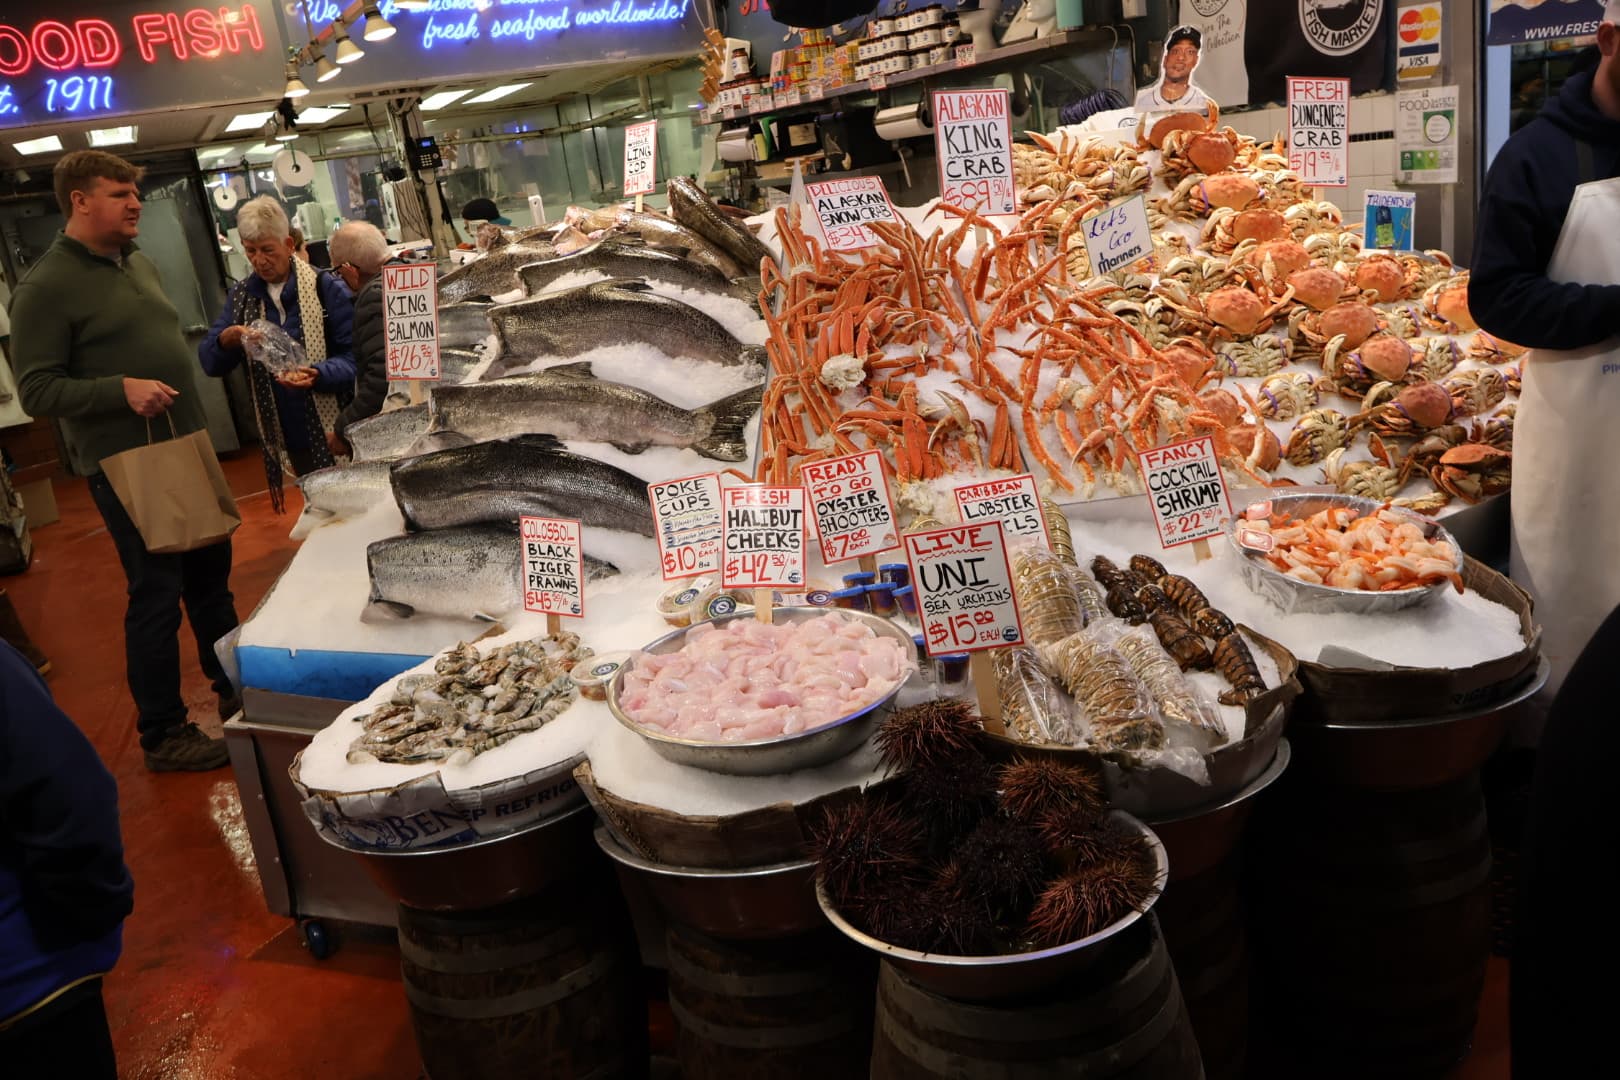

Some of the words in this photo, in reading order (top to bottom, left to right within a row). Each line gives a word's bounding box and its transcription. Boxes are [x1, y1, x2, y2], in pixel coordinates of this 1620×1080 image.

[133, 4, 263, 62] FISH
[423, 13, 480, 48] fresh
[491, 7, 570, 40] seafood
[575, 0, 689, 26] worldwide!
[1305, 8, 1330, 43] FISH
[1331, 0, 1378, 47] MARKET
[1409, 55, 1430, 67] VISA
[46, 75, 113, 112] 1911
[1292, 81, 1343, 100] FRESH
[939, 93, 1003, 121] ALASKAN
[1399, 99, 1431, 112] FOOD
[944, 121, 1003, 154] KING
[1293, 130, 1342, 147] CRAB
[627, 145, 652, 161] LING
[1290, 150, 1316, 177] $19
[628, 160, 647, 174] COD
[946, 156, 1006, 178] CRAB
[810, 178, 876, 197] DELICIOUS
[818, 191, 886, 212] ALASKAN
[820, 209, 860, 227] SNOW
[860, 205, 892, 220] CRAB
[1089, 207, 1127, 239] Let's
[827, 224, 867, 247] $34
[1109, 228, 1134, 250] Go
[386, 268, 429, 290] WILD
[386, 294, 428, 316] KING
[388, 320, 434, 341] SALMON
[389, 344, 421, 372] $26
[1145, 440, 1207, 468] FANCY
[809, 457, 866, 482] READY
[1148, 461, 1217, 491] COCKTAIL
[654, 478, 707, 501] POKE
[814, 484, 842, 497] TO
[849, 476, 872, 490] GO
[959, 481, 1023, 501] CARIBBEAN
[658, 492, 711, 516] CUPS
[731, 490, 790, 506] FRESH
[817, 490, 880, 516] OYSTER
[963, 494, 1035, 519] LOBSTER
[1156, 482, 1222, 516] SHRIMP
[727, 508, 802, 529] HALIBUT
[819, 505, 890, 534] SHOOTERS
[1163, 512, 1204, 535] $22
[523, 519, 575, 541] COLOSSOL
[726, 532, 800, 550] CHEEKS
[527, 542, 574, 558] BLACK
[698, 546, 719, 557] EACH
[824, 534, 849, 558] $7
[849, 540, 870, 551] EACH
[911, 528, 992, 555] LIVE
[528, 560, 574, 576] TIGER
[663, 546, 696, 573] $10
[725, 553, 772, 583] $42
[528, 574, 578, 594] PRAWNS
[919, 557, 989, 592] UNI
[526, 591, 551, 610] $45
[924, 600, 951, 612] SEA
[957, 587, 1012, 607] URCHINS
[928, 613, 977, 647] $15
[979, 628, 1000, 642] EACH
